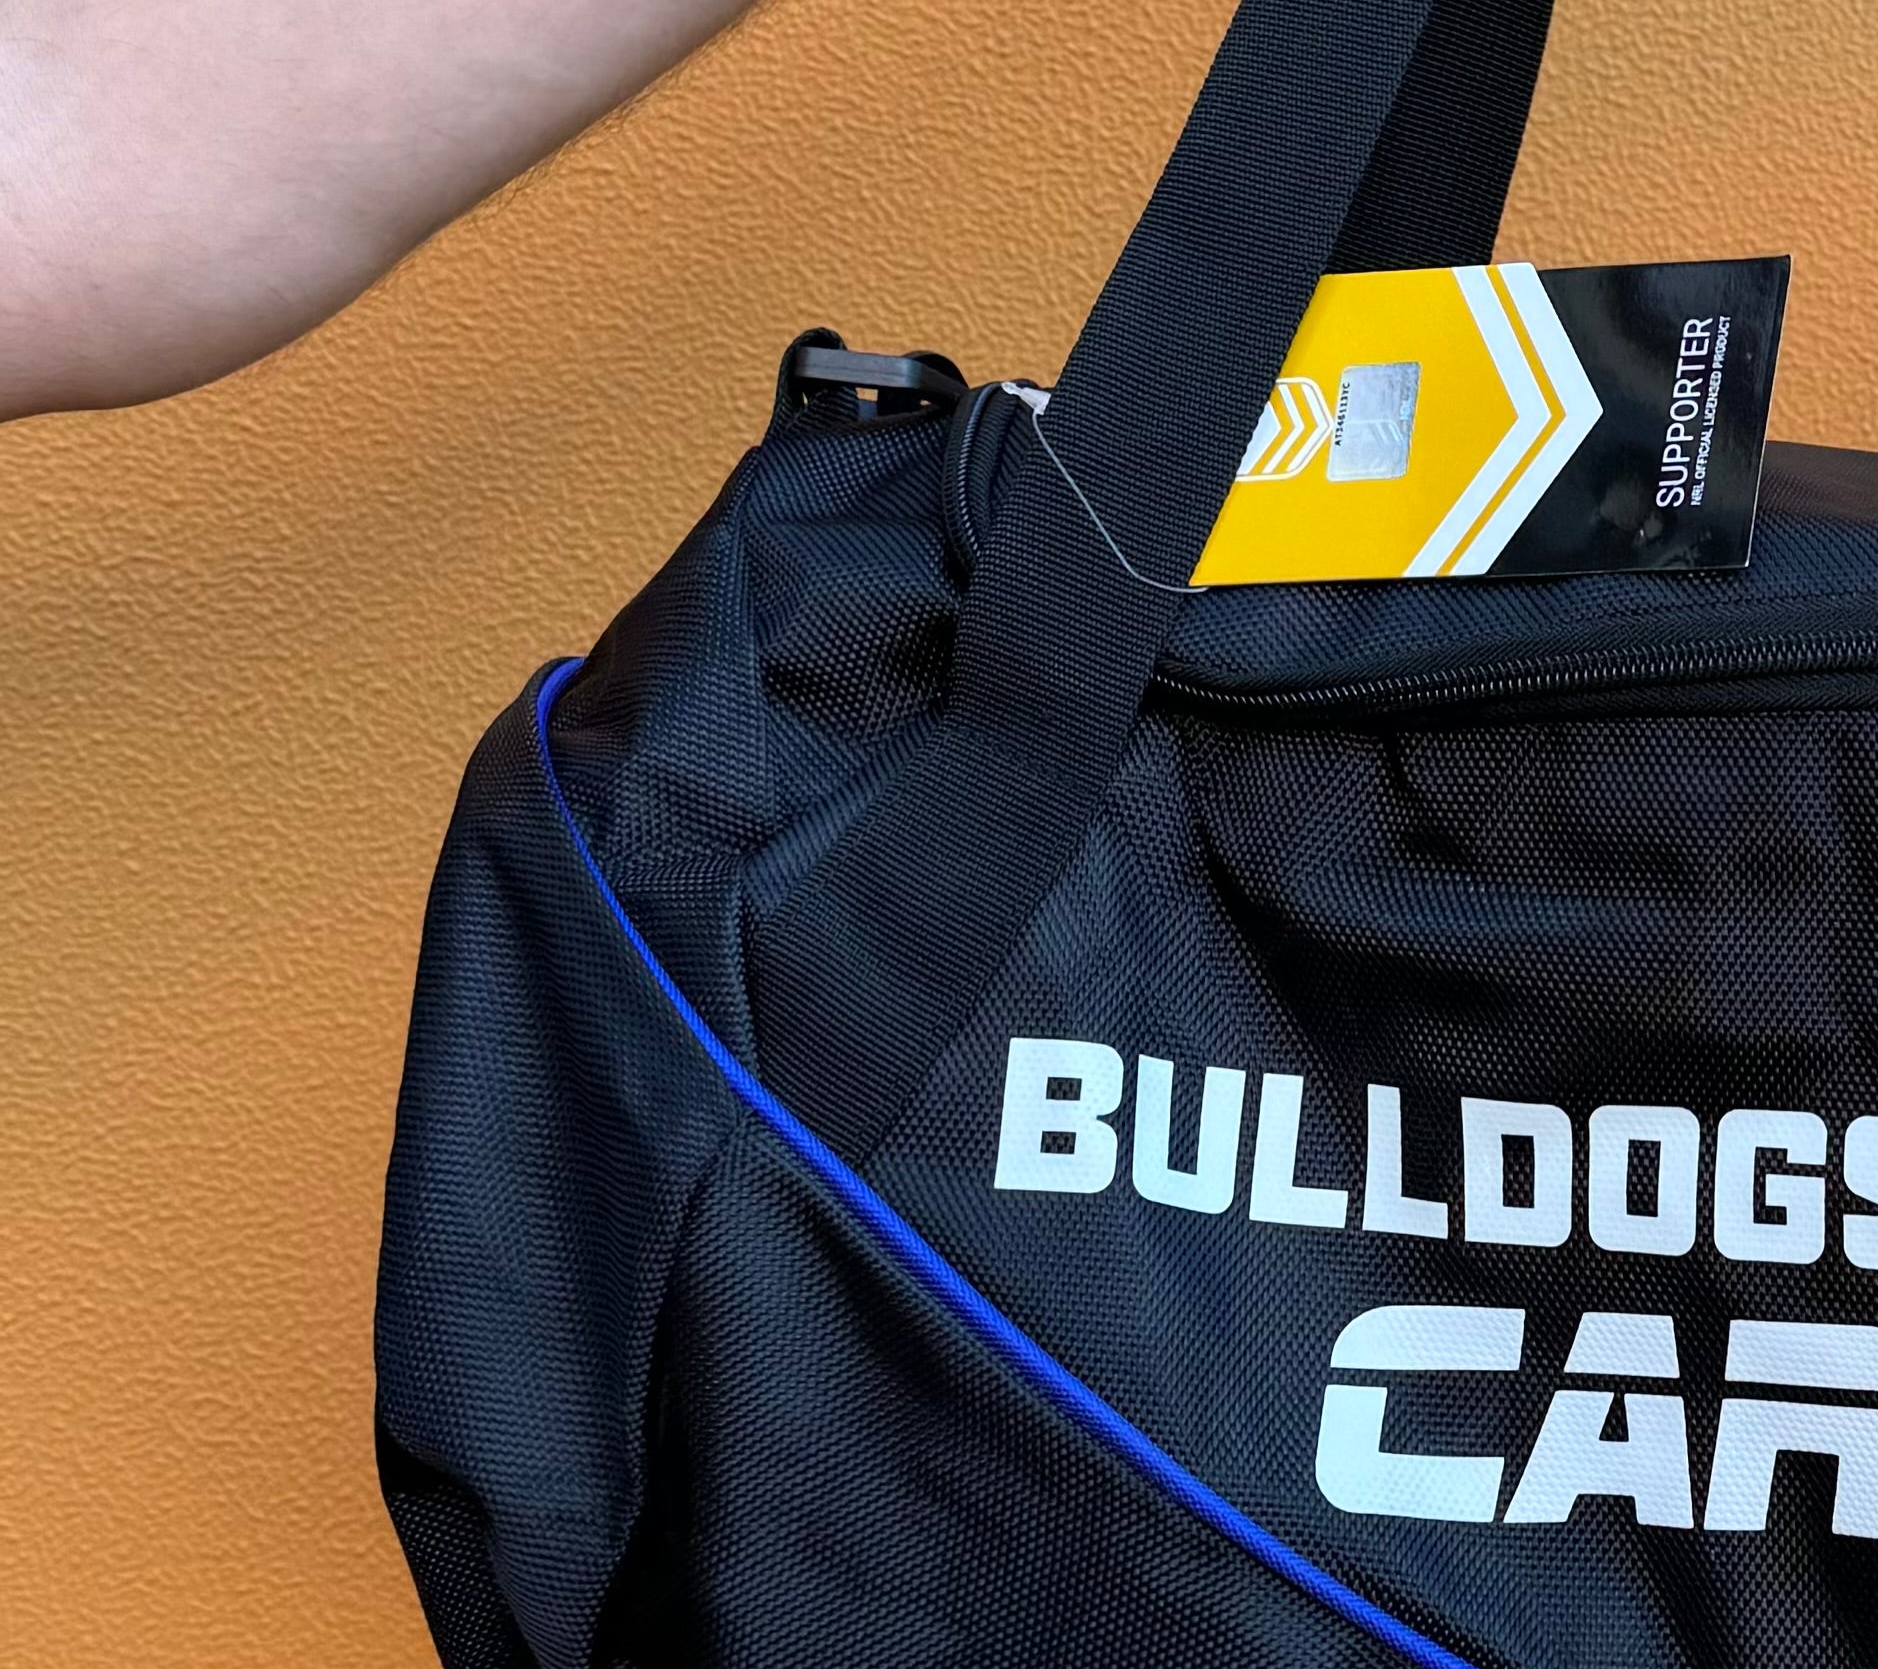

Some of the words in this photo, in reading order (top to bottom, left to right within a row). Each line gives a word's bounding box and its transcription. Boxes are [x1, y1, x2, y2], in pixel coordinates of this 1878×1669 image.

[1711, 315, 1731, 369] PRODUCT
[1655, 317, 1714, 508] SUPPORTER
[1702, 370, 1722, 426] LICENSED
[1694, 427, 1714, 480] OFFICIAL
